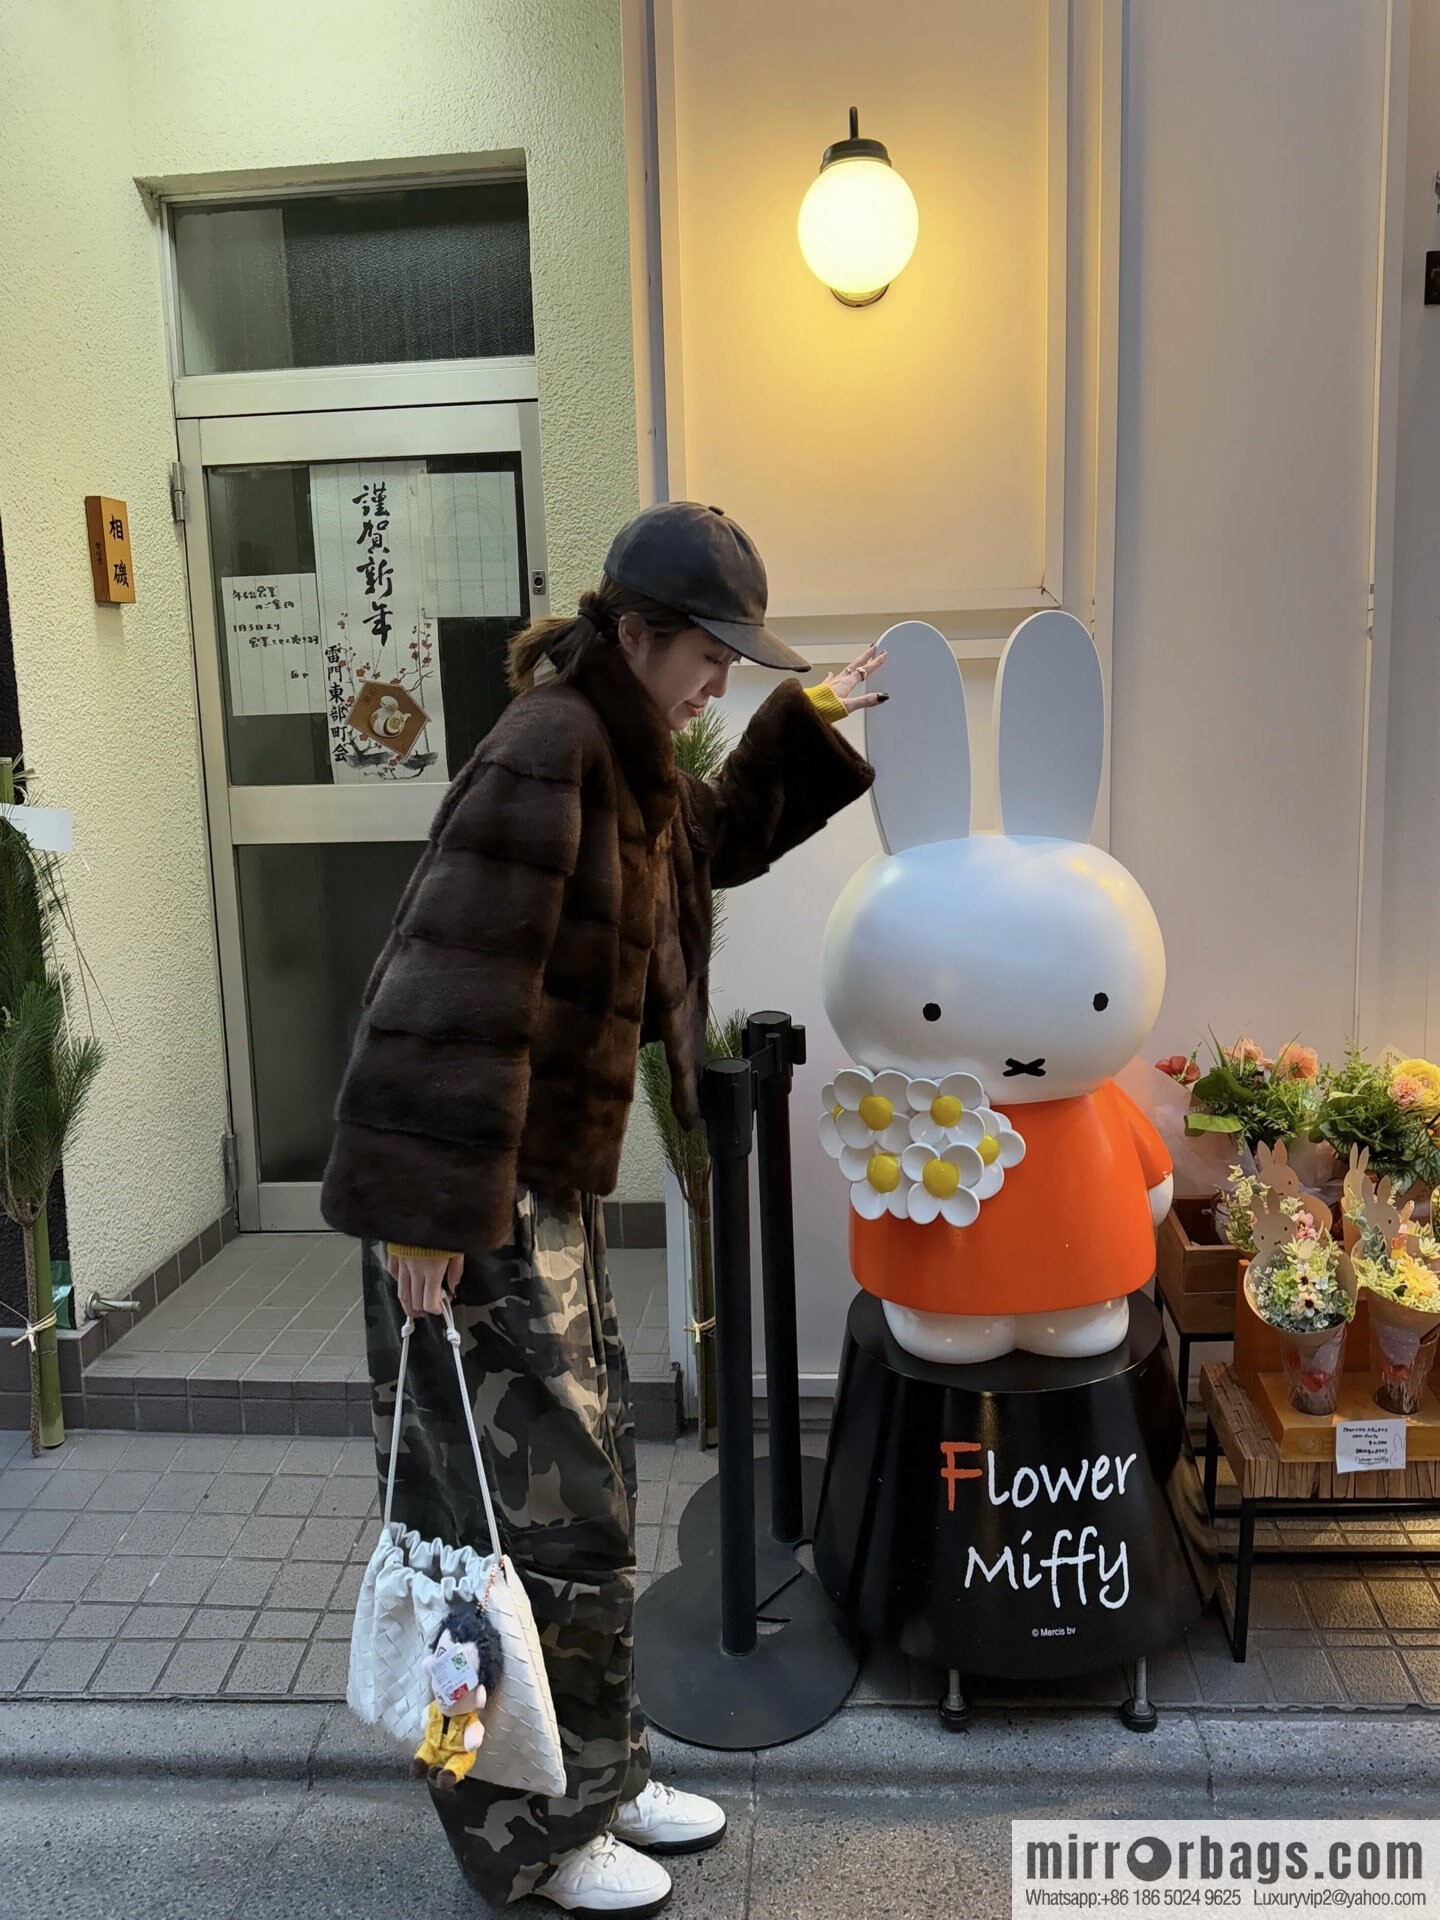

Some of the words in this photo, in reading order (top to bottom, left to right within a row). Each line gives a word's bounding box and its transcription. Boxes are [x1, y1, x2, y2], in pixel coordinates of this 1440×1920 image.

[109, 513, 129, 588] 相磯
[352, 481, 394, 647] 謹賀新年
[324, 644, 349, 763] 雷門東部町会
[940, 1441, 1137, 1512] Flower
[964, 1525, 1130, 1609] Miffy
[1040, 1628, 1066, 1637] Mercis
[1066, 1626, 1076, 1635] bv
